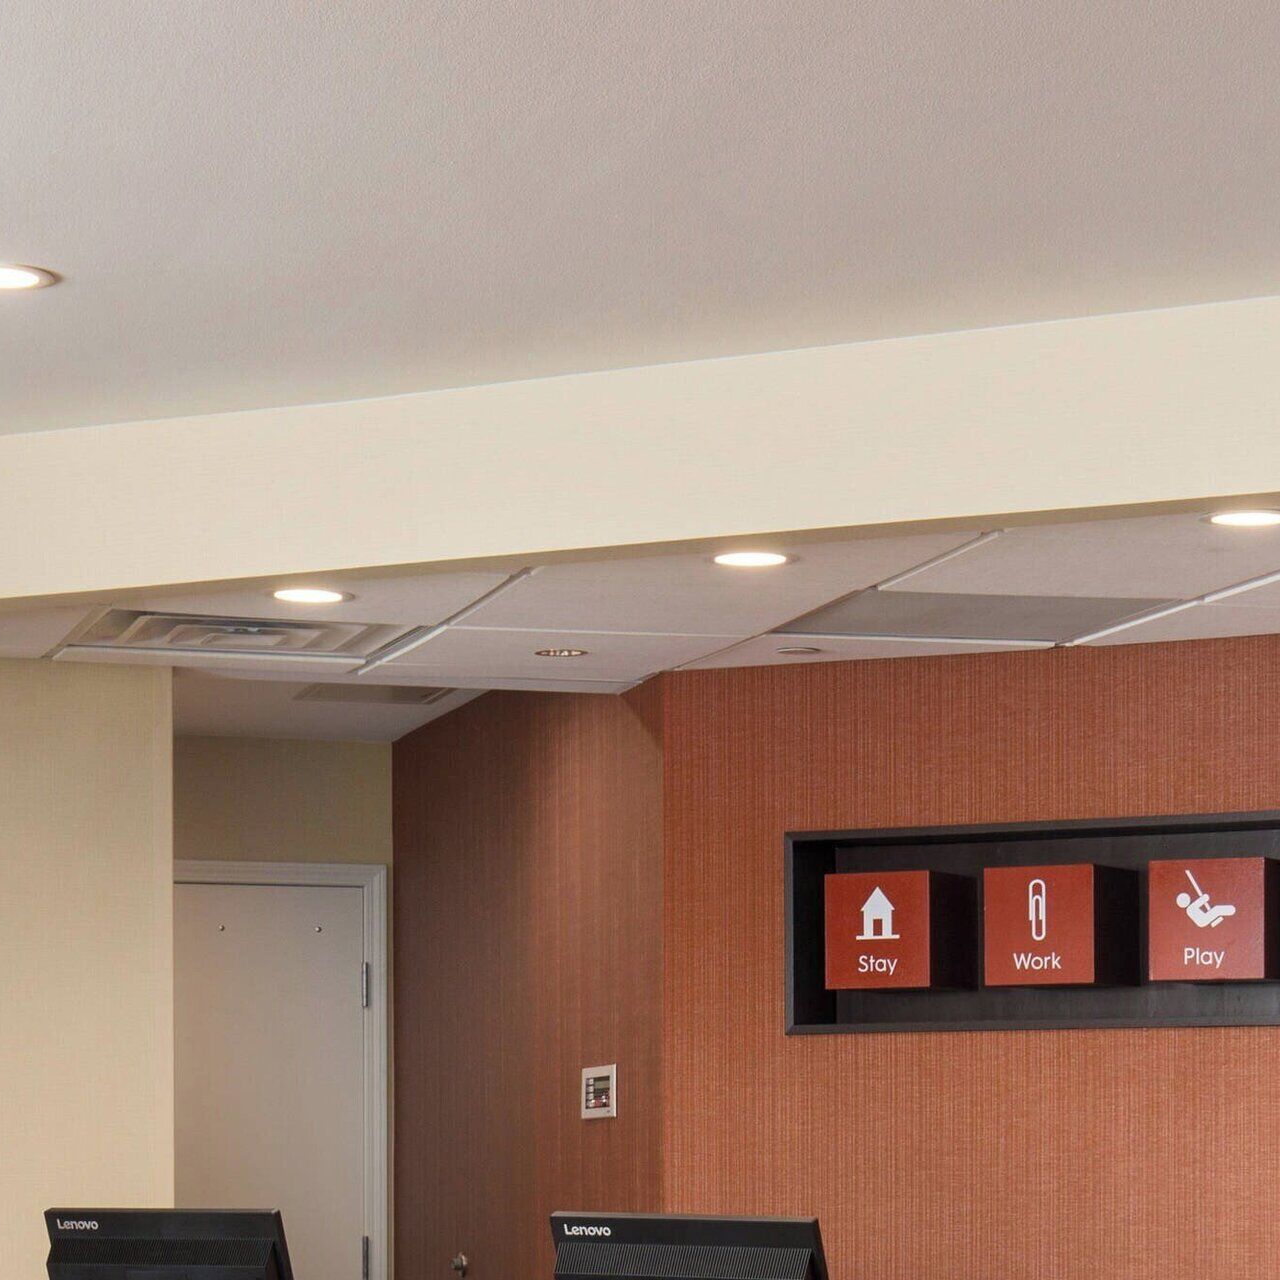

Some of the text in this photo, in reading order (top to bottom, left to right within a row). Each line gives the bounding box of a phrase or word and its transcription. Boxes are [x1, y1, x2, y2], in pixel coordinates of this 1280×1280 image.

[857, 954, 898, 975] Stay
[1013, 952, 1062, 970] Work
[1183, 947, 1225, 968] Play
[56, 1218, 99, 1230] Lenovo
[563, 1223, 611, 1236] Lenovo
